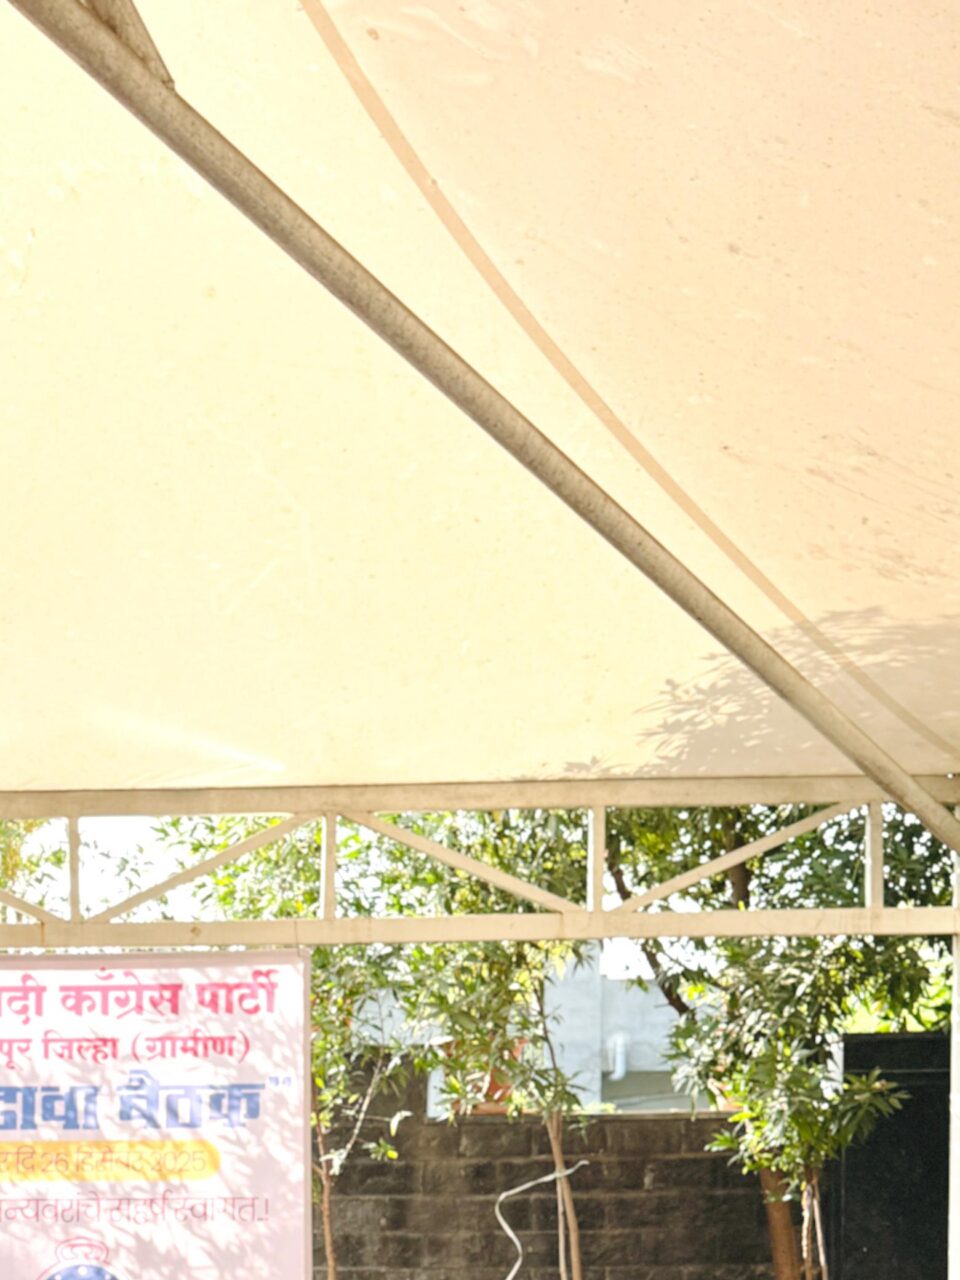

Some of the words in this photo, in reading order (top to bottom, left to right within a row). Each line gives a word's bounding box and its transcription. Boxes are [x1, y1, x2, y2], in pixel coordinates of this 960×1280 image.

[195, 969, 279, 1014] पार्टी
[41, 1029, 119, 1064] जिल्हा
[131, 1028, 251, 1064] (ग्रामीण)
